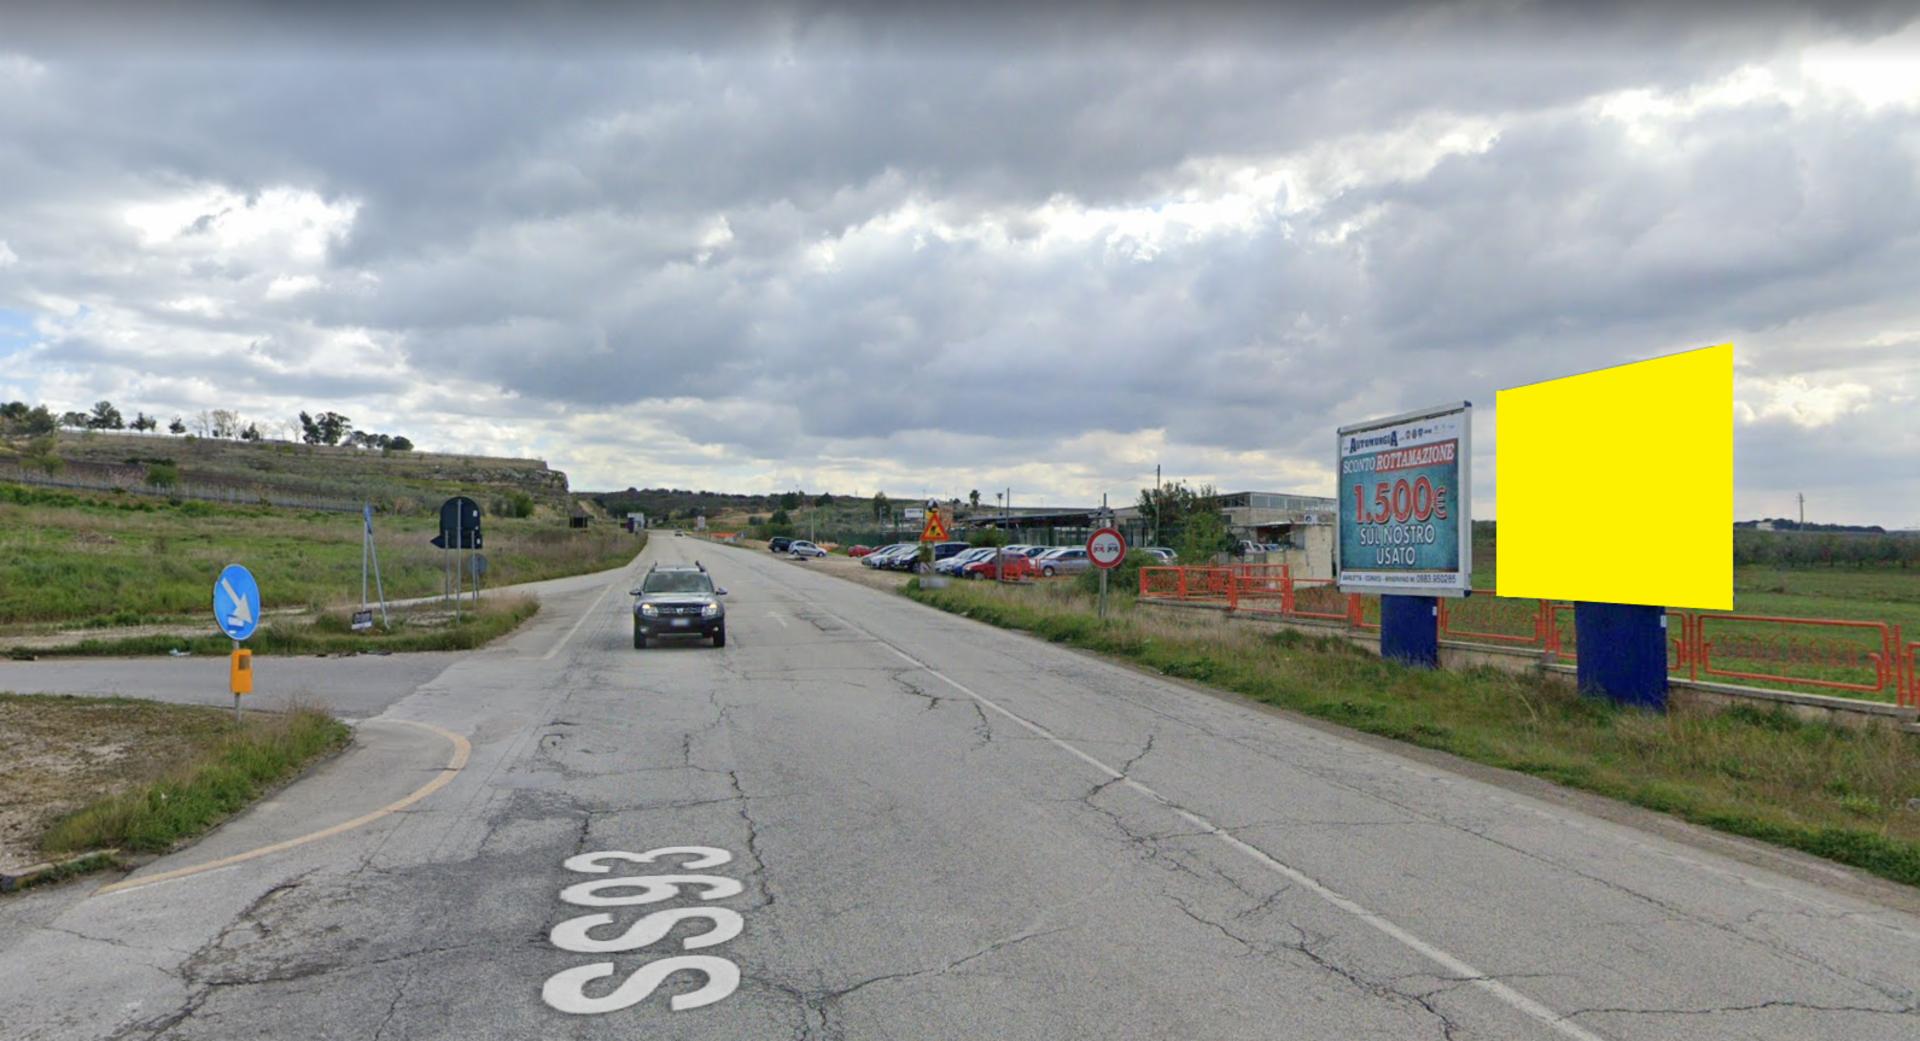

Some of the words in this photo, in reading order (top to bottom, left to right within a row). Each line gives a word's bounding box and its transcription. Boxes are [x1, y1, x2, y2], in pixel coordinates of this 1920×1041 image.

[1343, 457, 1375, 474] SCONTO
[1376, 443, 1455, 470] ROTTAMAZIONE
[1360, 526, 1380, 545] SUL
[1383, 524, 1435, 544] NOSTRO
[1376, 546, 1415, 565] USATO
